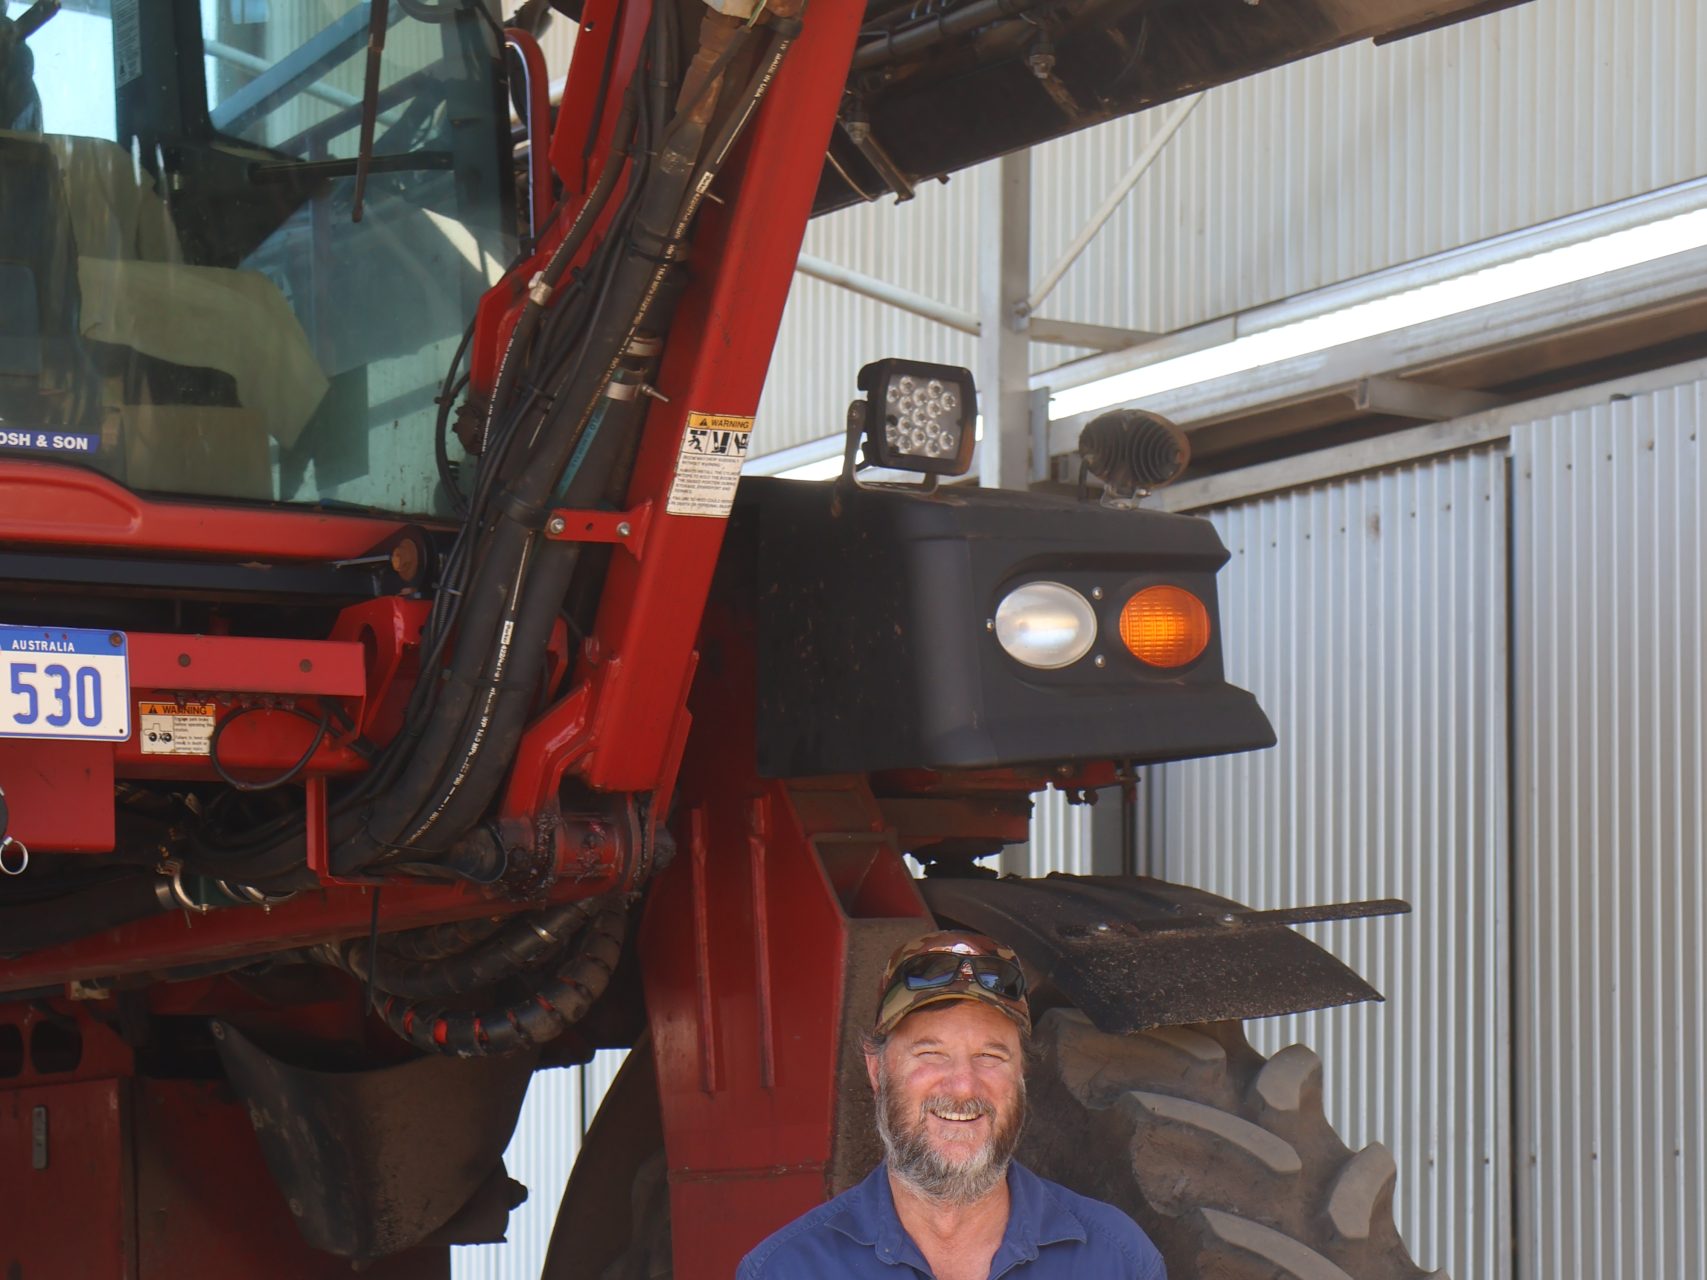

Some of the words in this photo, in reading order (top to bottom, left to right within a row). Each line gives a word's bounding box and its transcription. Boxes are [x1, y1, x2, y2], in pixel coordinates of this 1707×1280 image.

[711, 419, 750, 429] WARNING
[0, 431, 31, 447] OSH
[36, 434, 48, 448] &
[52, 435, 88, 450] SON
[12, 639, 75, 652] AUSTRALIA
[10, 662, 102, 727] 530
